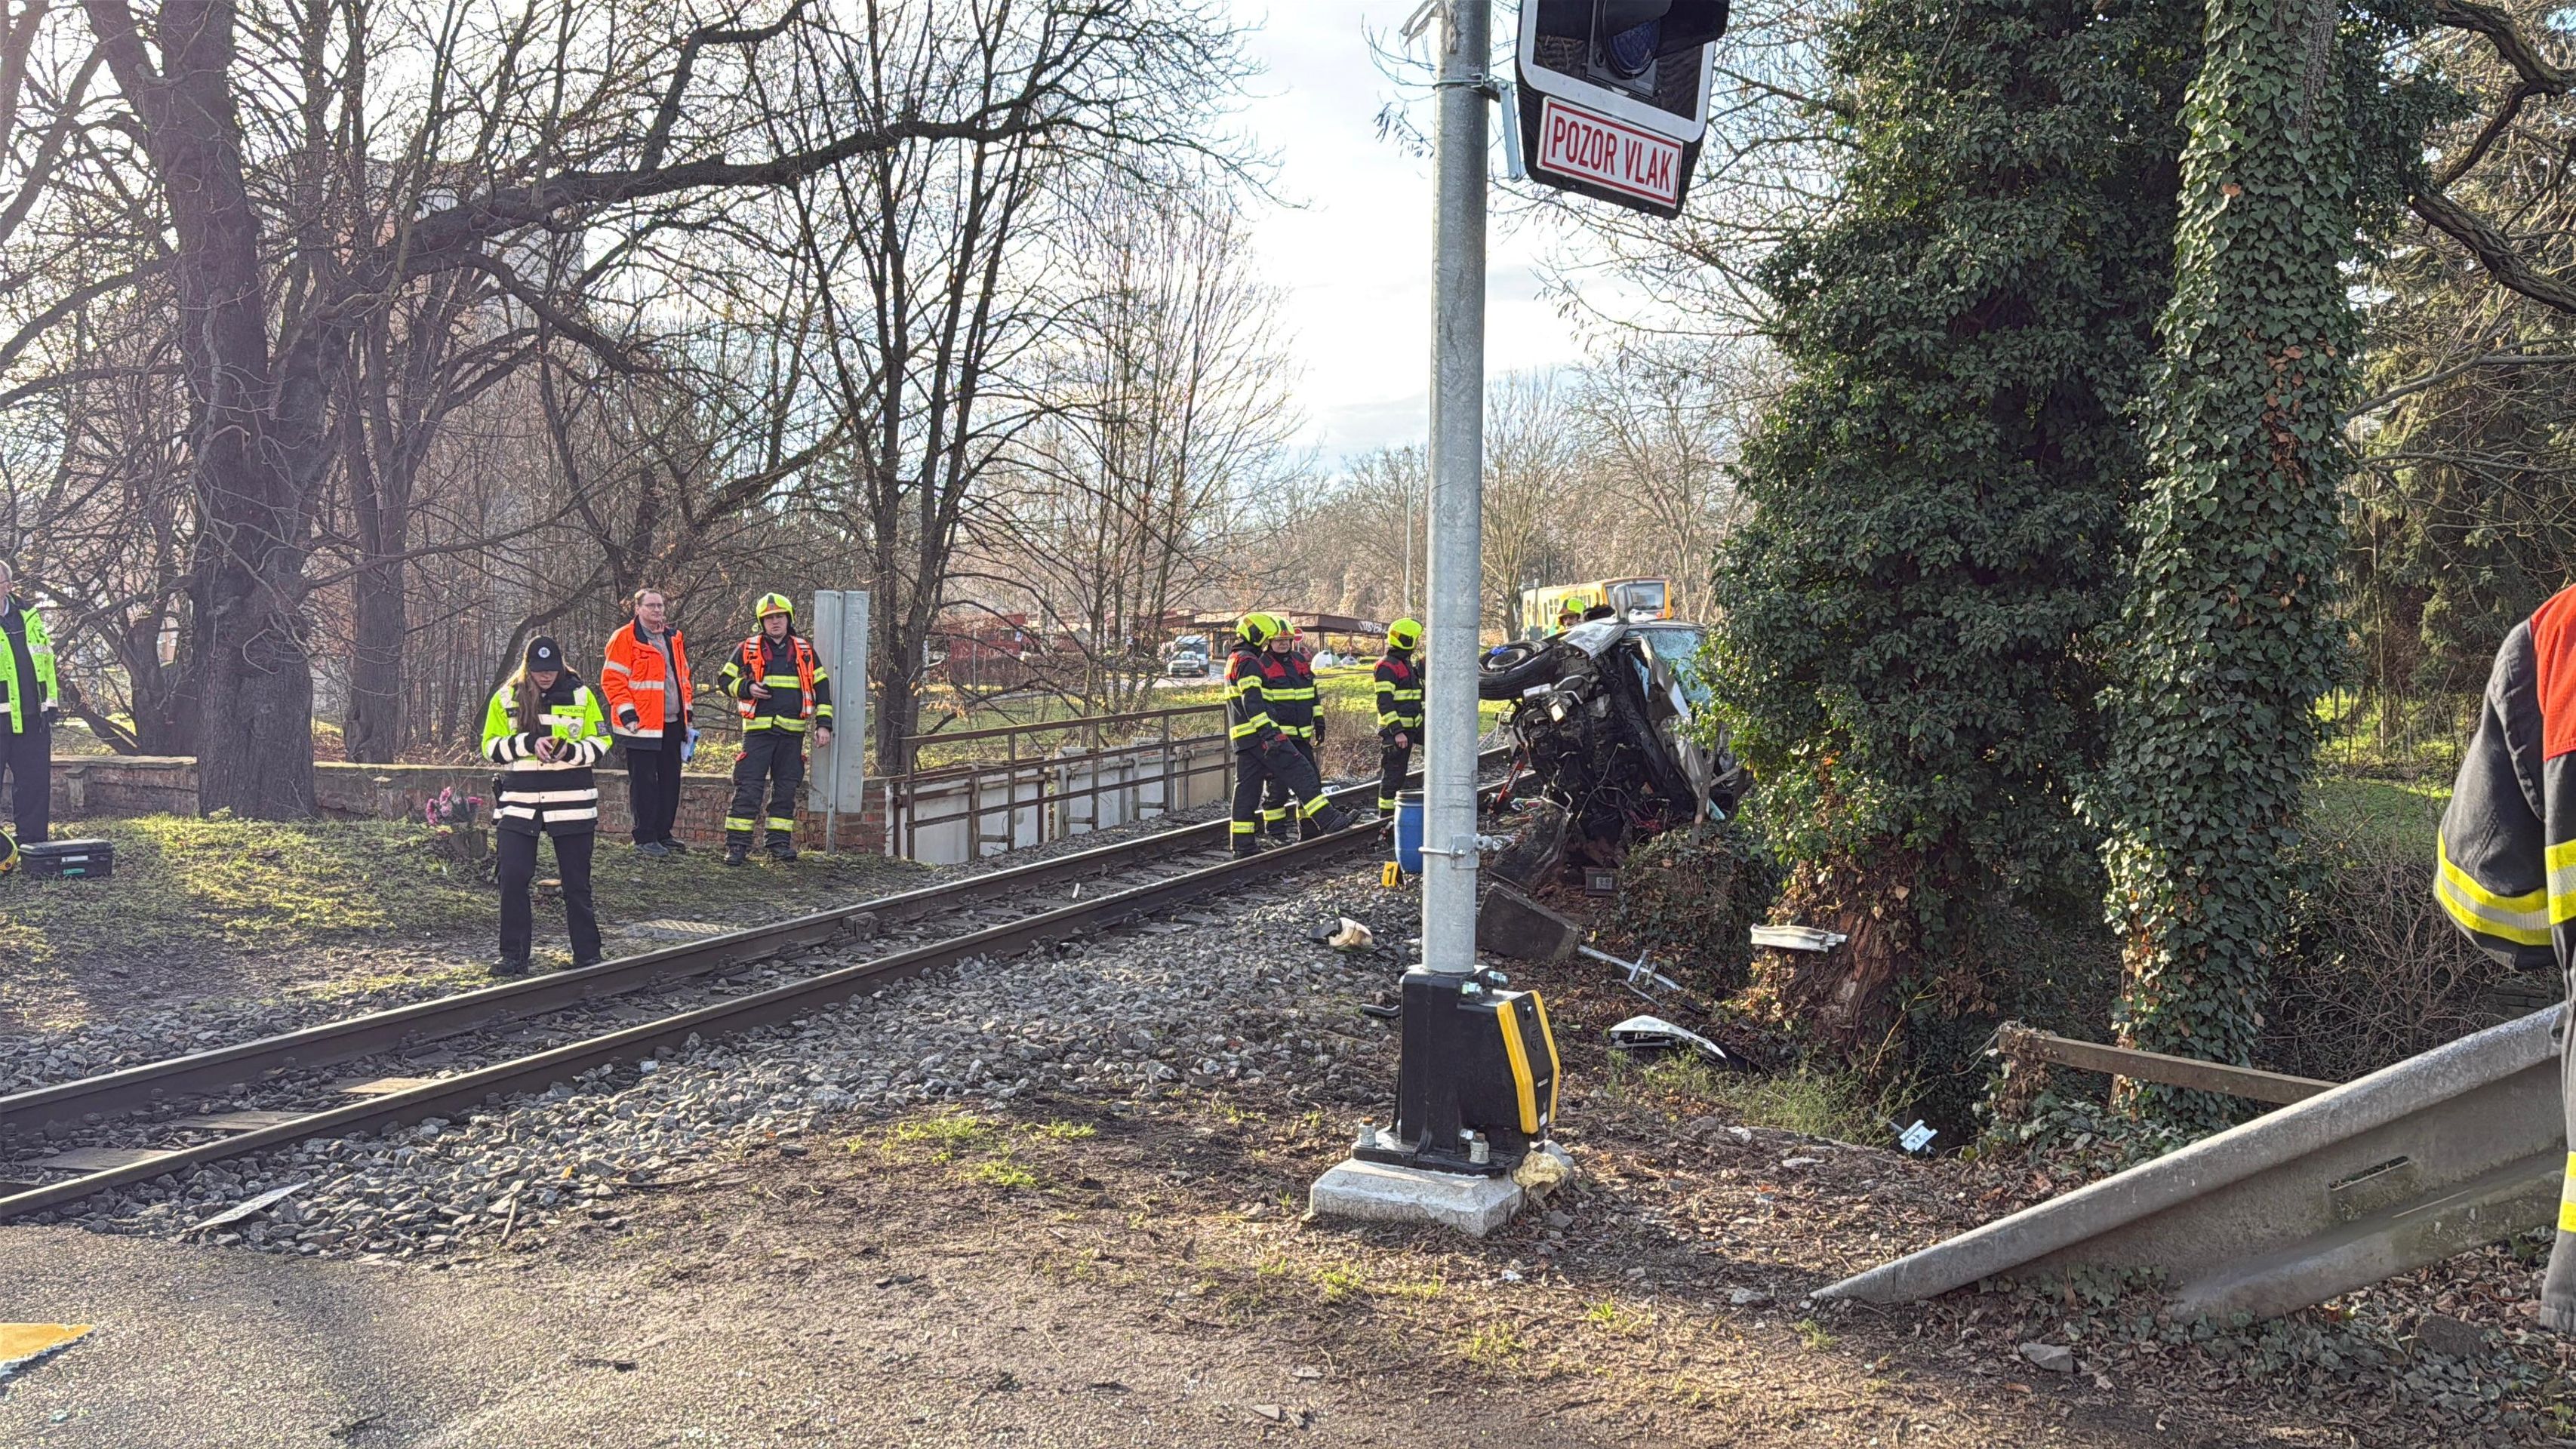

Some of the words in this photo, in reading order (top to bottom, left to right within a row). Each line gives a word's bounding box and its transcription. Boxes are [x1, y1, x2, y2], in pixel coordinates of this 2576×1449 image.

[1551, 115, 1617, 175] POZOR
[1625, 138, 1673, 192] VLAK
[1386, 866, 1395, 884] 1
